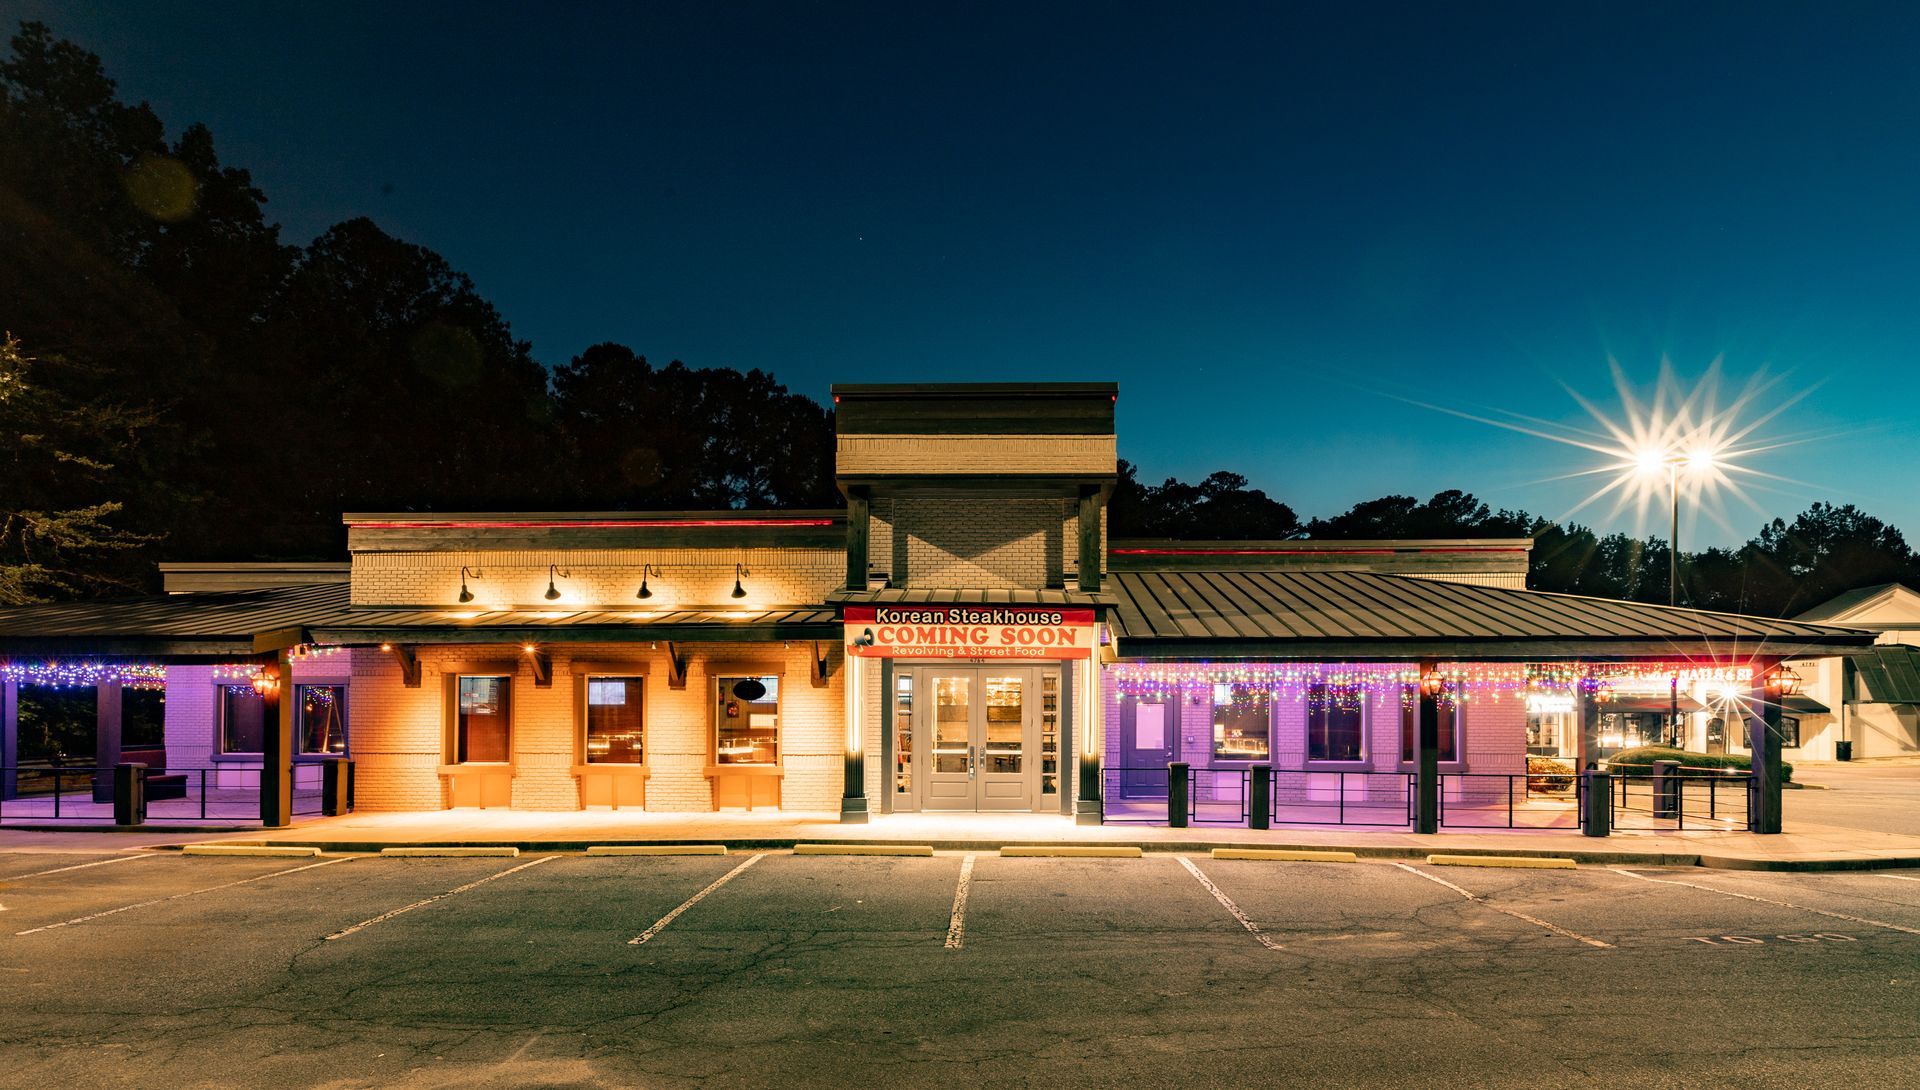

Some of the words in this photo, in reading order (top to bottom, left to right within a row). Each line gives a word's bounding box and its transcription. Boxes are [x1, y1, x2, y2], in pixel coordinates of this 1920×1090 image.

[876, 608, 944, 624] Korean
[949, 608, 1062, 625] Steakhouse
[877, 626, 988, 645] COMING
[1000, 627, 1078, 646] SOON
[892, 646, 954, 658] Revolving
[957, 646, 967, 656] &
[970, 646, 1010, 656] Street
[1015, 647, 1045, 656] Food
[1679, 667, 1724, 681] NAILS
[1681, 935, 1764, 945] TO
[1776, 933, 1858, 943] GO
